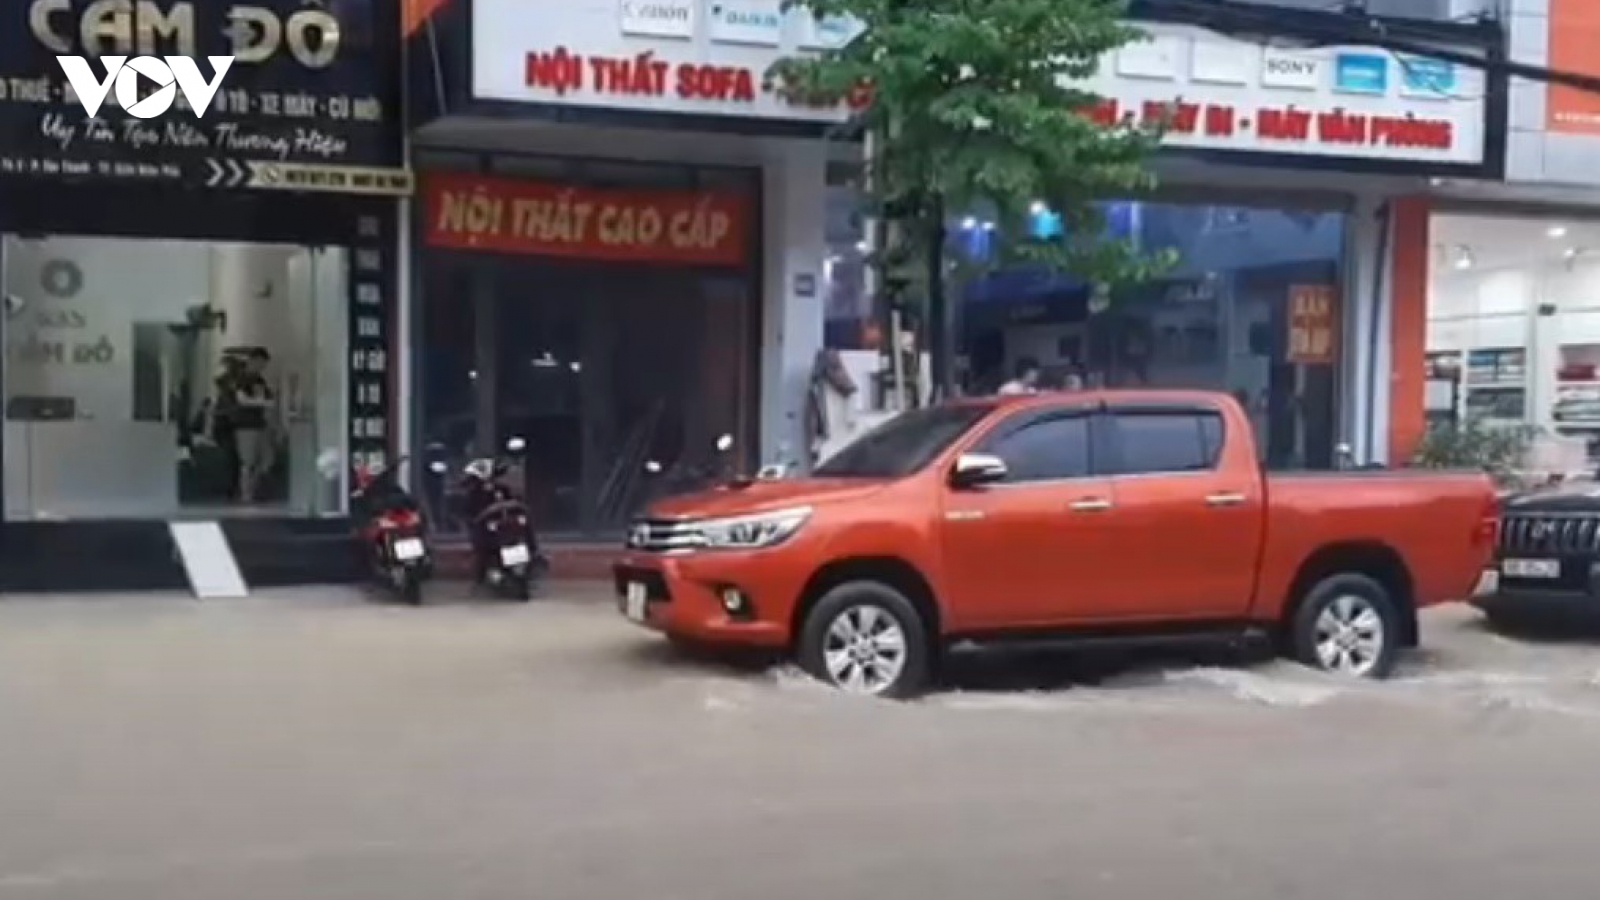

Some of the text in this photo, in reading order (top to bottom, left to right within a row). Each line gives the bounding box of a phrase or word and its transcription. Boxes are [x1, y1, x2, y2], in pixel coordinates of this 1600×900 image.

[525, 45, 582, 96] NỘI
[589, 50, 668, 96] THẤT
[676, 61, 755, 102] SOFA
[1266, 58, 1315, 75] SONY
[1256, 103, 1312, 140] MÁY
[438, 185, 730, 248] NỘI THẤT CAO CẤP
